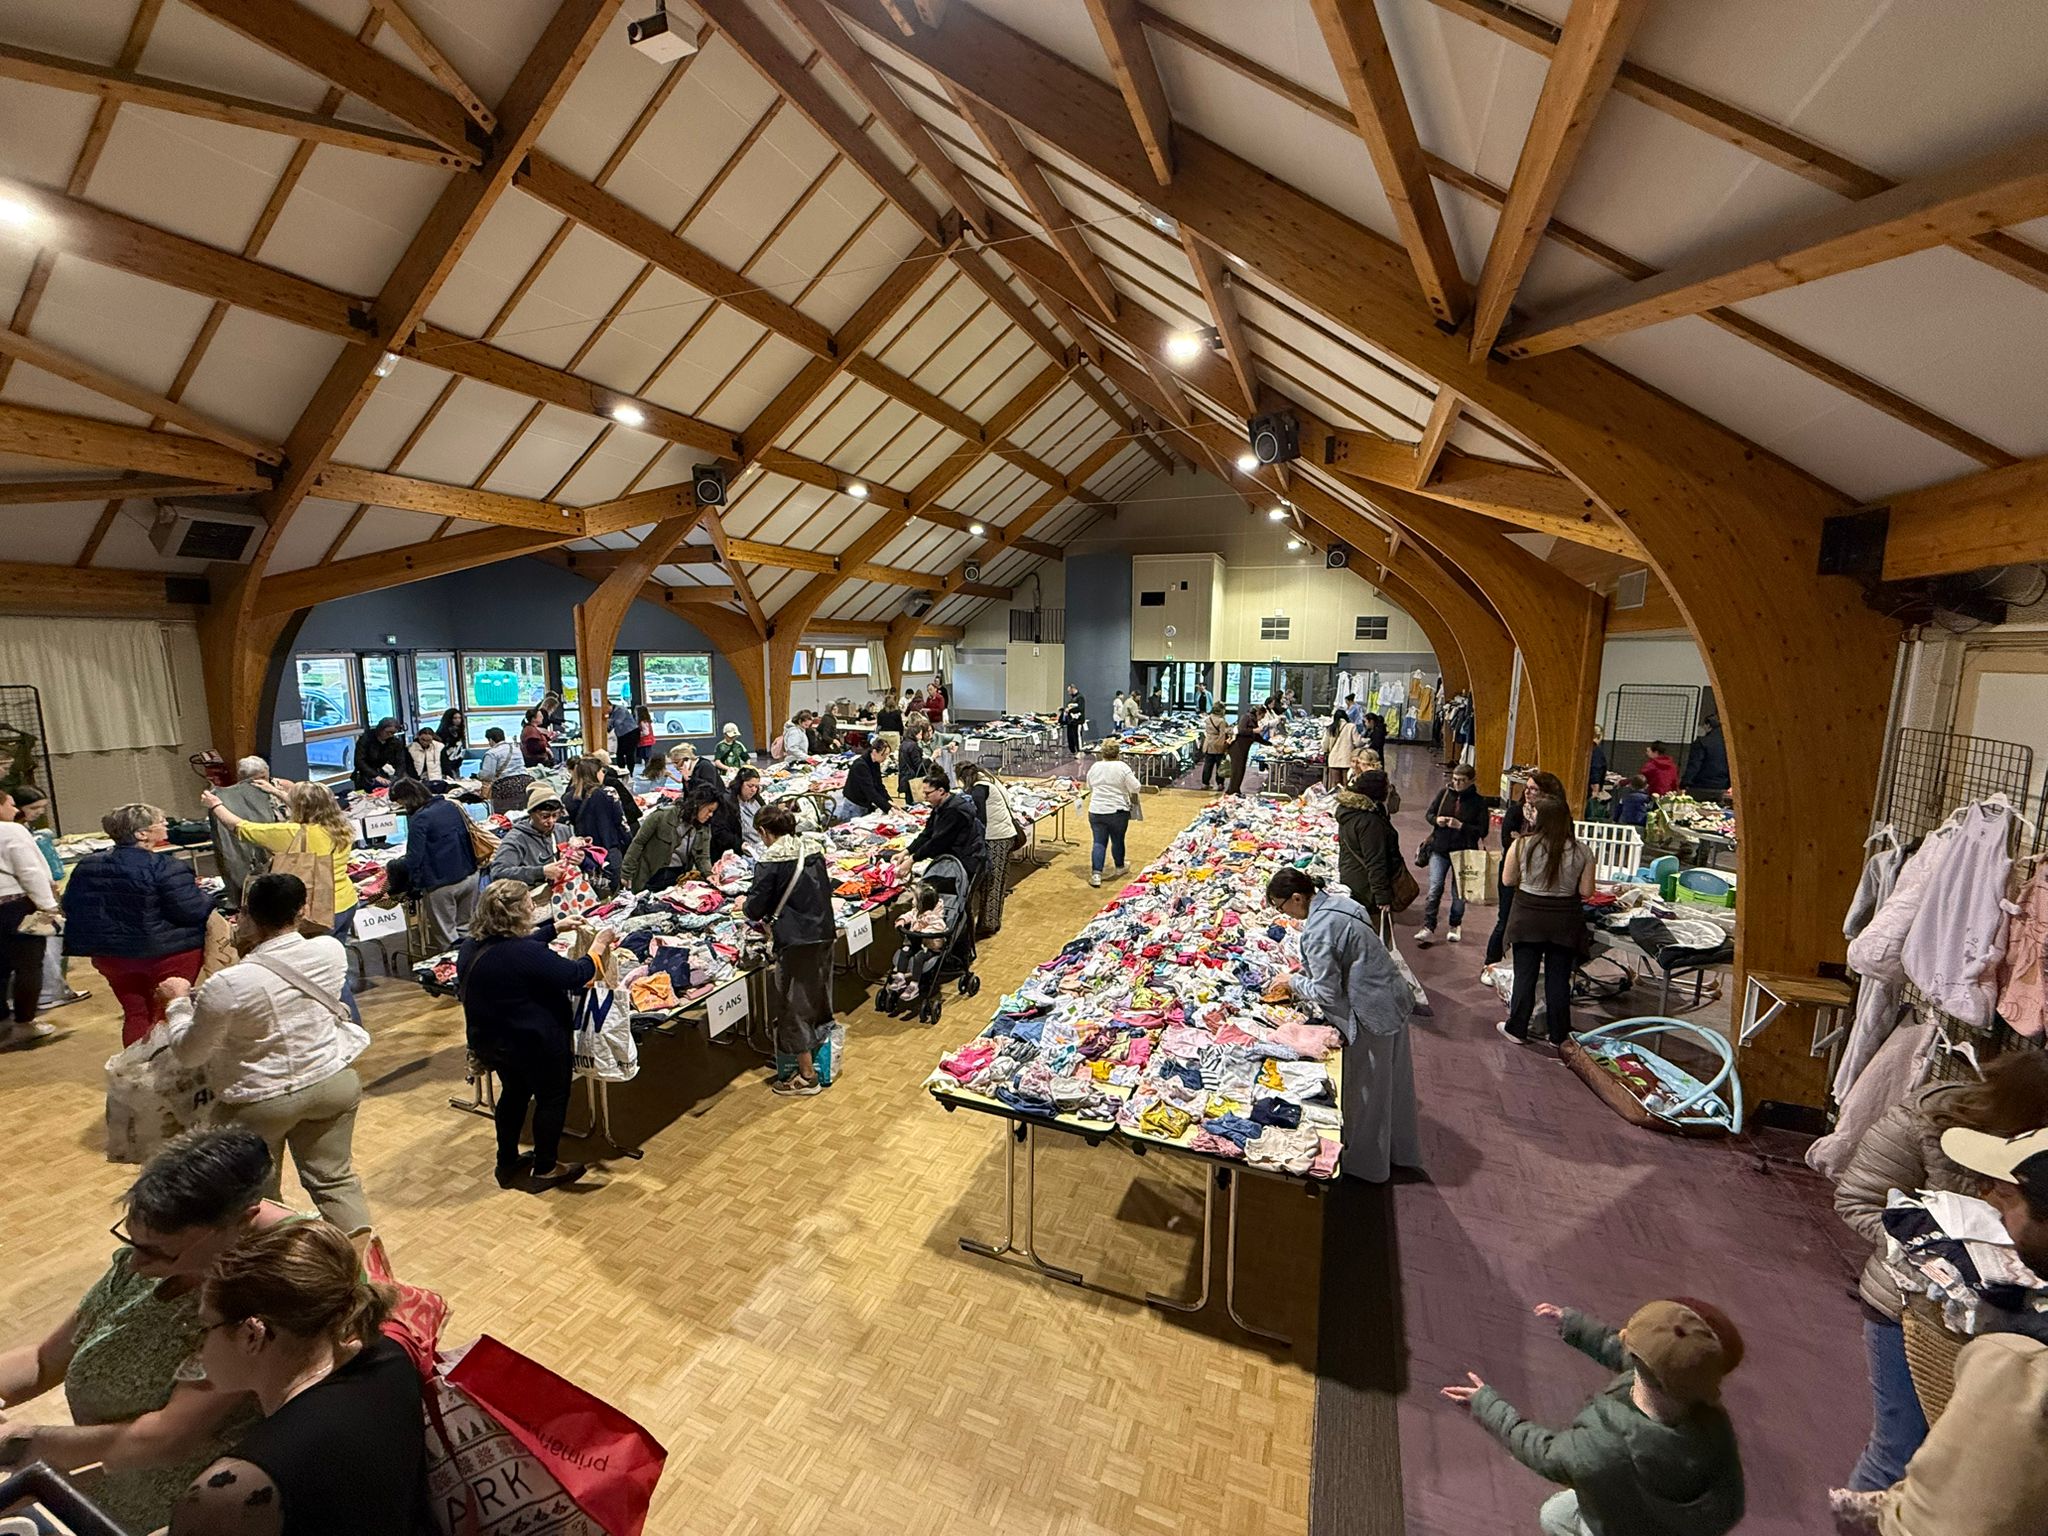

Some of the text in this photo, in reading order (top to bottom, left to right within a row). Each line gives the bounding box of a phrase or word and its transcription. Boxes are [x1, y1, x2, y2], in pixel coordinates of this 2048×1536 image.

[363, 912, 397, 927] 10 ANS
[718, 994, 742, 1016] 5 ANS
